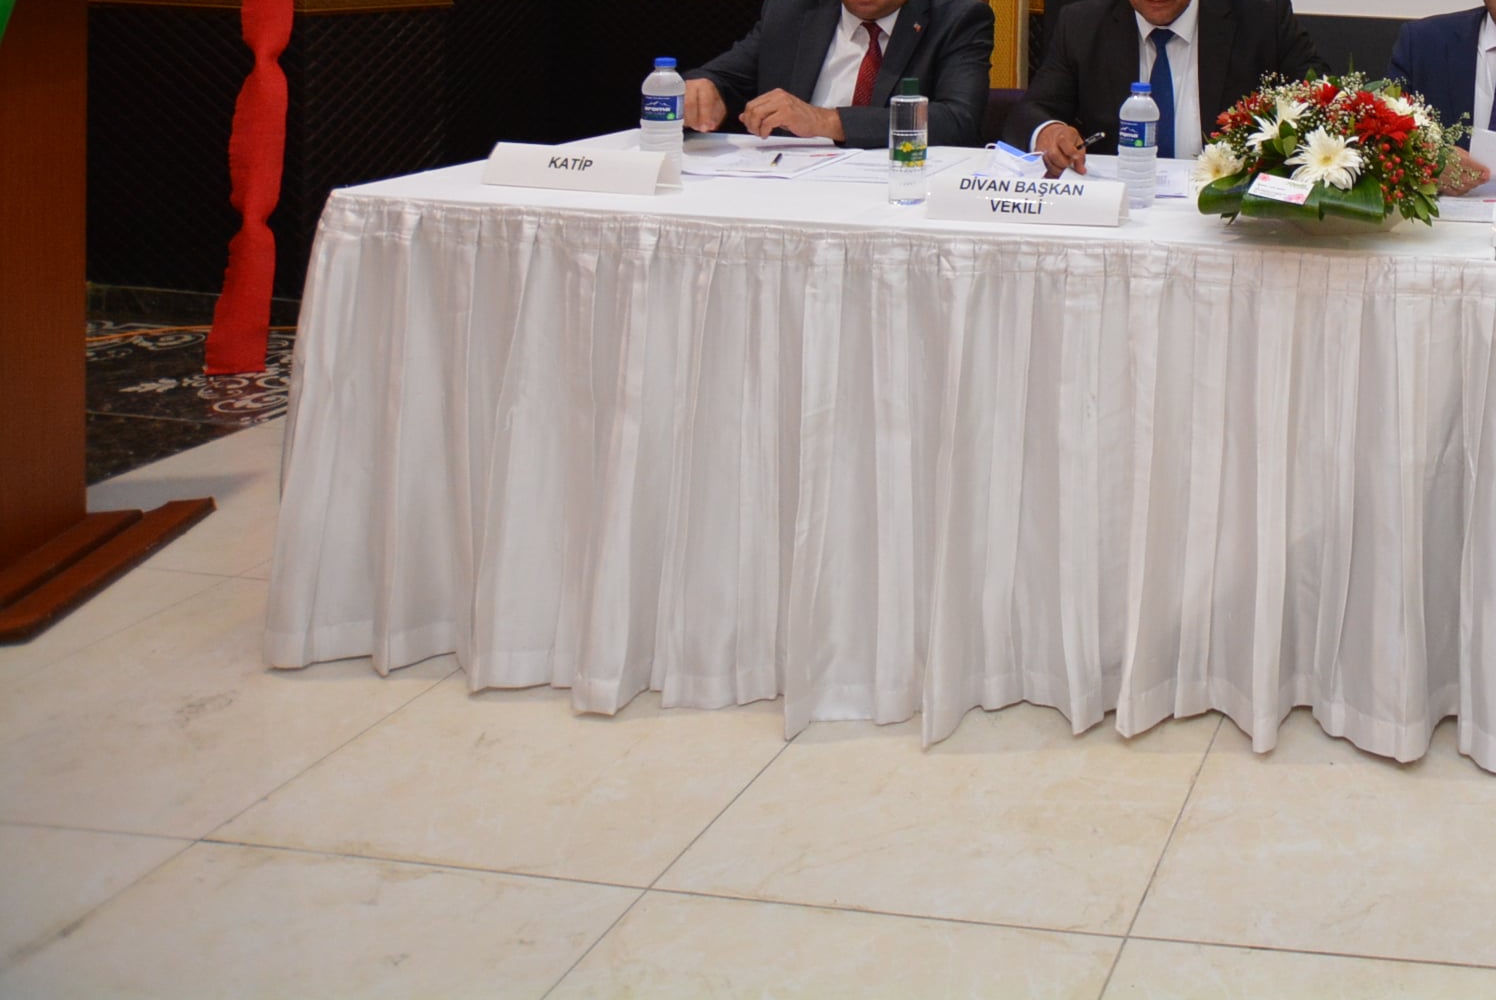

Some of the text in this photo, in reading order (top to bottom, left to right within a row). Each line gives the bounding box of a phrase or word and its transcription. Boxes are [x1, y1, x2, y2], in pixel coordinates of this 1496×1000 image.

[548, 156, 593, 171] KATİP
[960, 176, 1085, 197] DİVAN BAŞKAN
[990, 198, 1043, 215] VEKİLİ
